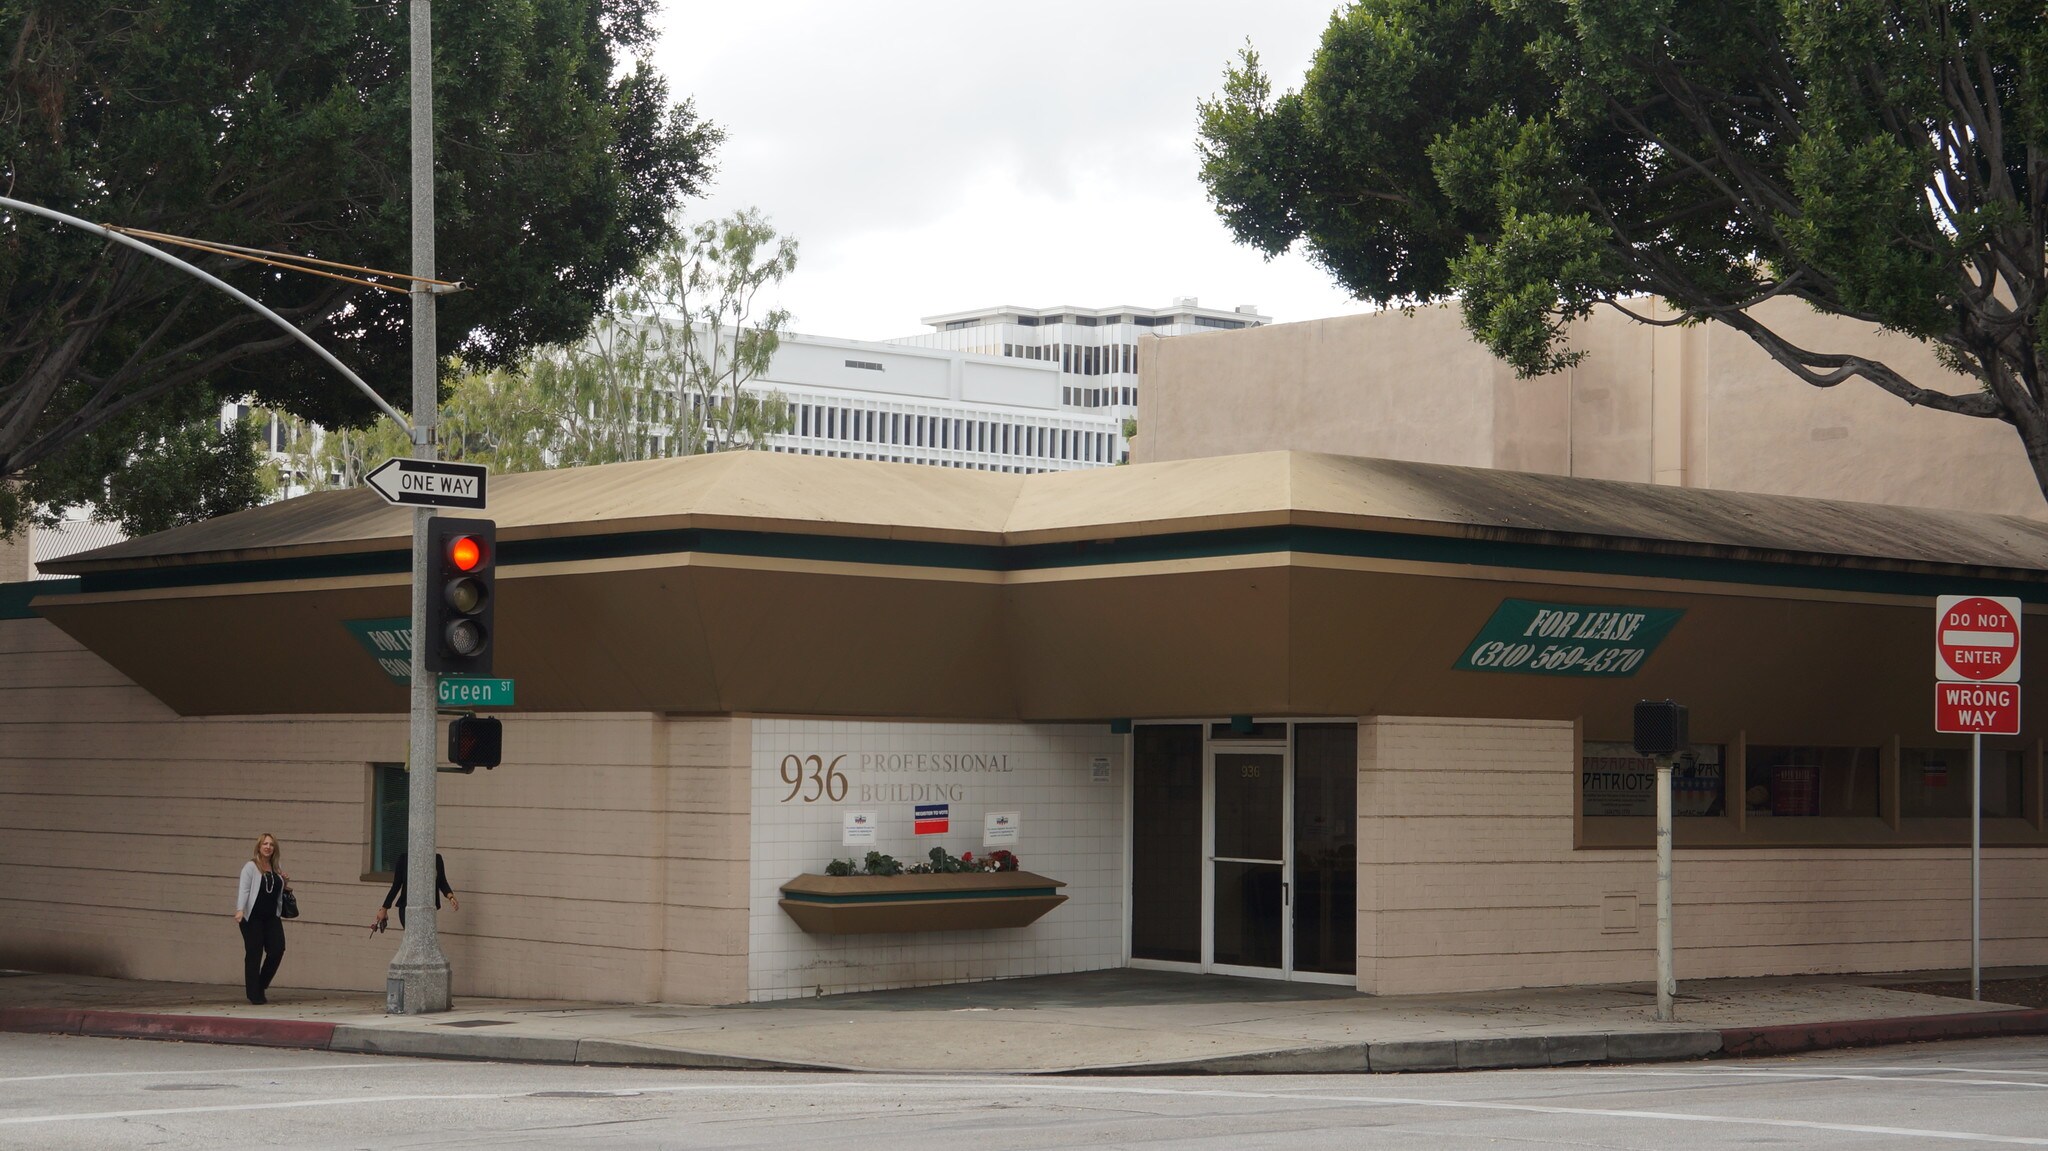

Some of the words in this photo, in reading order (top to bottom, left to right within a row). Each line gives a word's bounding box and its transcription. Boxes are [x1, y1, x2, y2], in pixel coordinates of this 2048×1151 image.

[402, 473, 434, 492] ONE
[440, 477, 473, 494] WAY
[1523, 609, 1579, 637] FOR
[1572, 612, 1646, 641] LEASE
[1950, 613, 1971, 626] DO
[1978, 614, 2007, 628] NOT
[367, 630, 404, 651] FOR
[1471, 640, 1536, 668] (310)
[1530, 644, 1645, 673] 569-4370
[1955, 650, 2001, 664] ENTER
[439, 681, 492, 701] Green
[501, 681, 511, 692] ST
[1946, 689, 2010, 707] WRONG
[1958, 710, 1997, 726] WAY
[860, 754, 1014, 773] PROFESSIONAL
[1241, 765, 1260, 778] 936
[780, 754, 848, 803] 936
[1583, 772, 1655, 790] PATRIOTS
[860, 783, 963, 802] BUILDING
